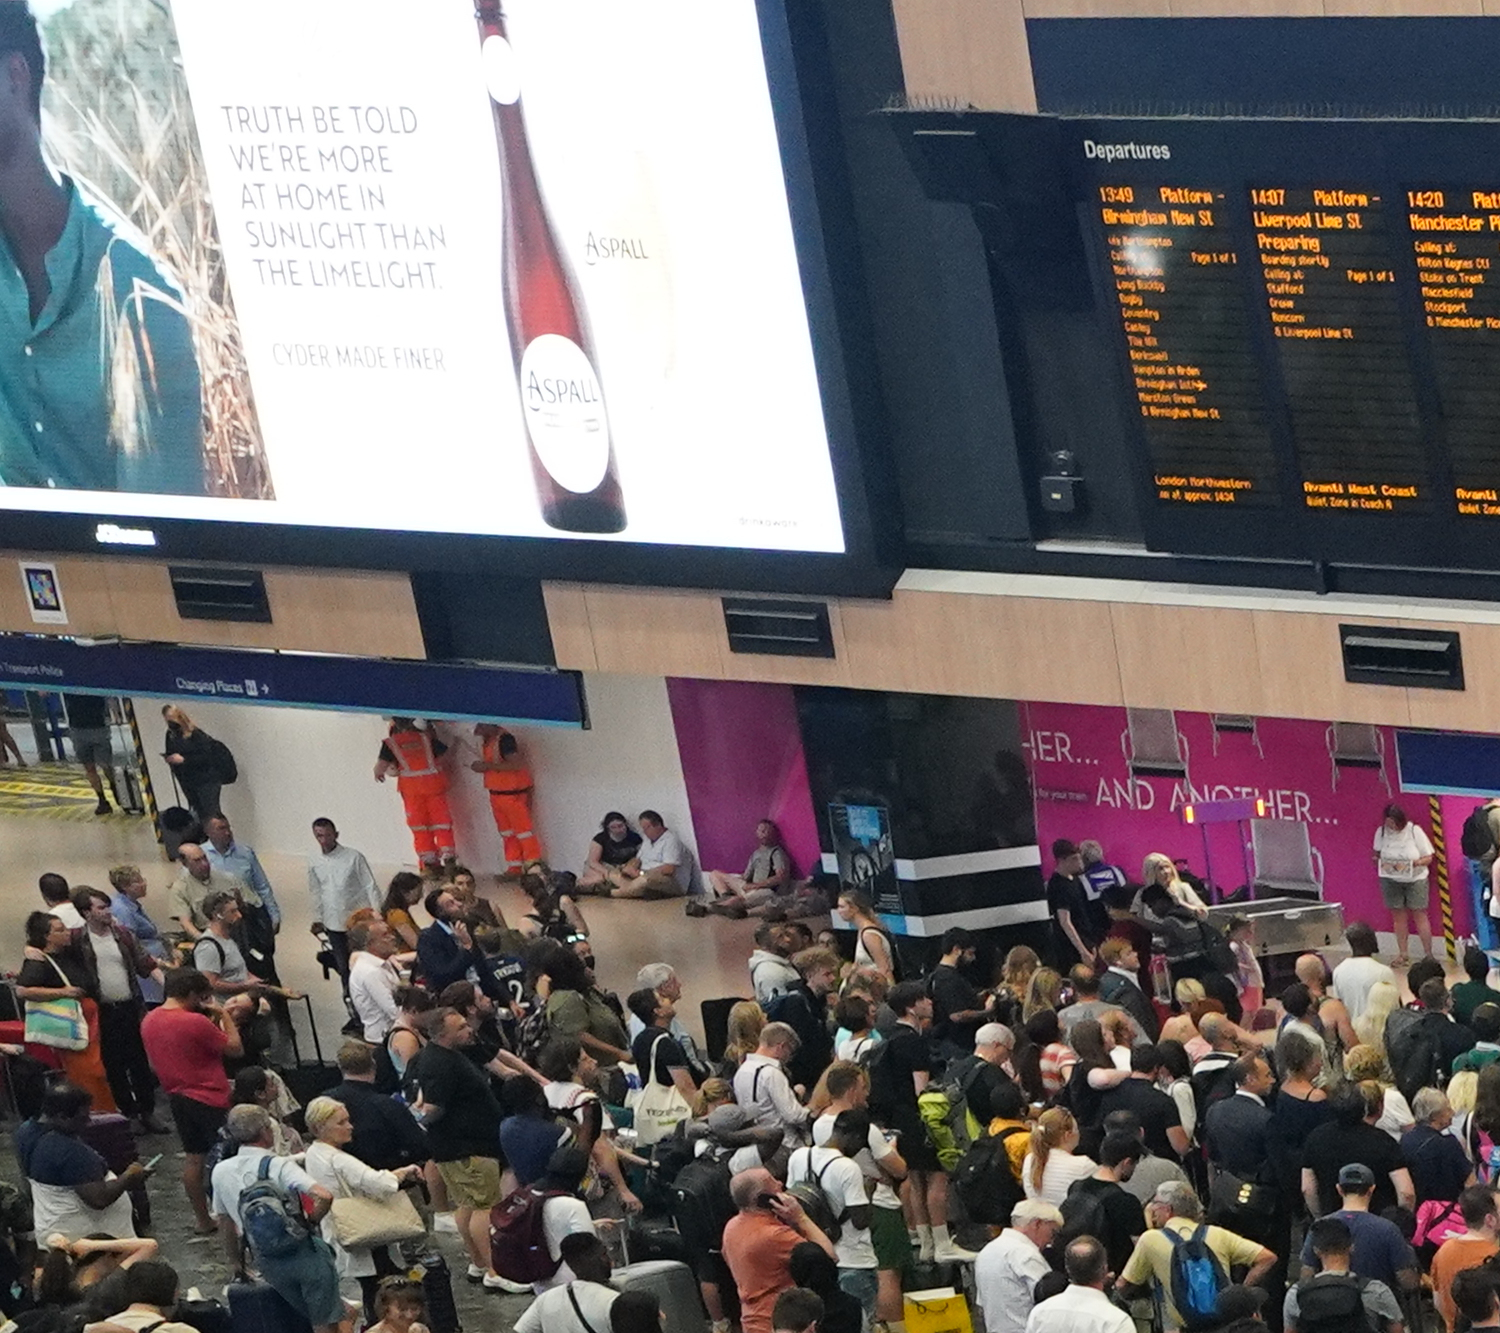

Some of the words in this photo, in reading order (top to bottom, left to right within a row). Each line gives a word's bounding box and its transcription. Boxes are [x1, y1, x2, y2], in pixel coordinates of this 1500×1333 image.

[221, 105, 307, 134] TRUTH
[312, 107, 345, 134] BE
[349, 107, 418, 135] TOLD
[229, 143, 314, 172] WE'RE
[319, 145, 392, 174] MORE
[1084, 140, 1170, 162] Departures
[239, 182, 270, 211] AT
[274, 183, 350, 213] HOME
[360, 184, 386, 212] IN
[244, 221, 368, 251] SUNLIGHT
[373, 223, 447, 251] THAN
[252, 258, 304, 287] THE
[309, 259, 445, 290] LIMELIGHT.
[271, 342, 329, 368] CYDER
[334, 344, 389, 370] MADE
[392, 345, 446, 371] FINER
[1095, 777, 1154, 810] AND
